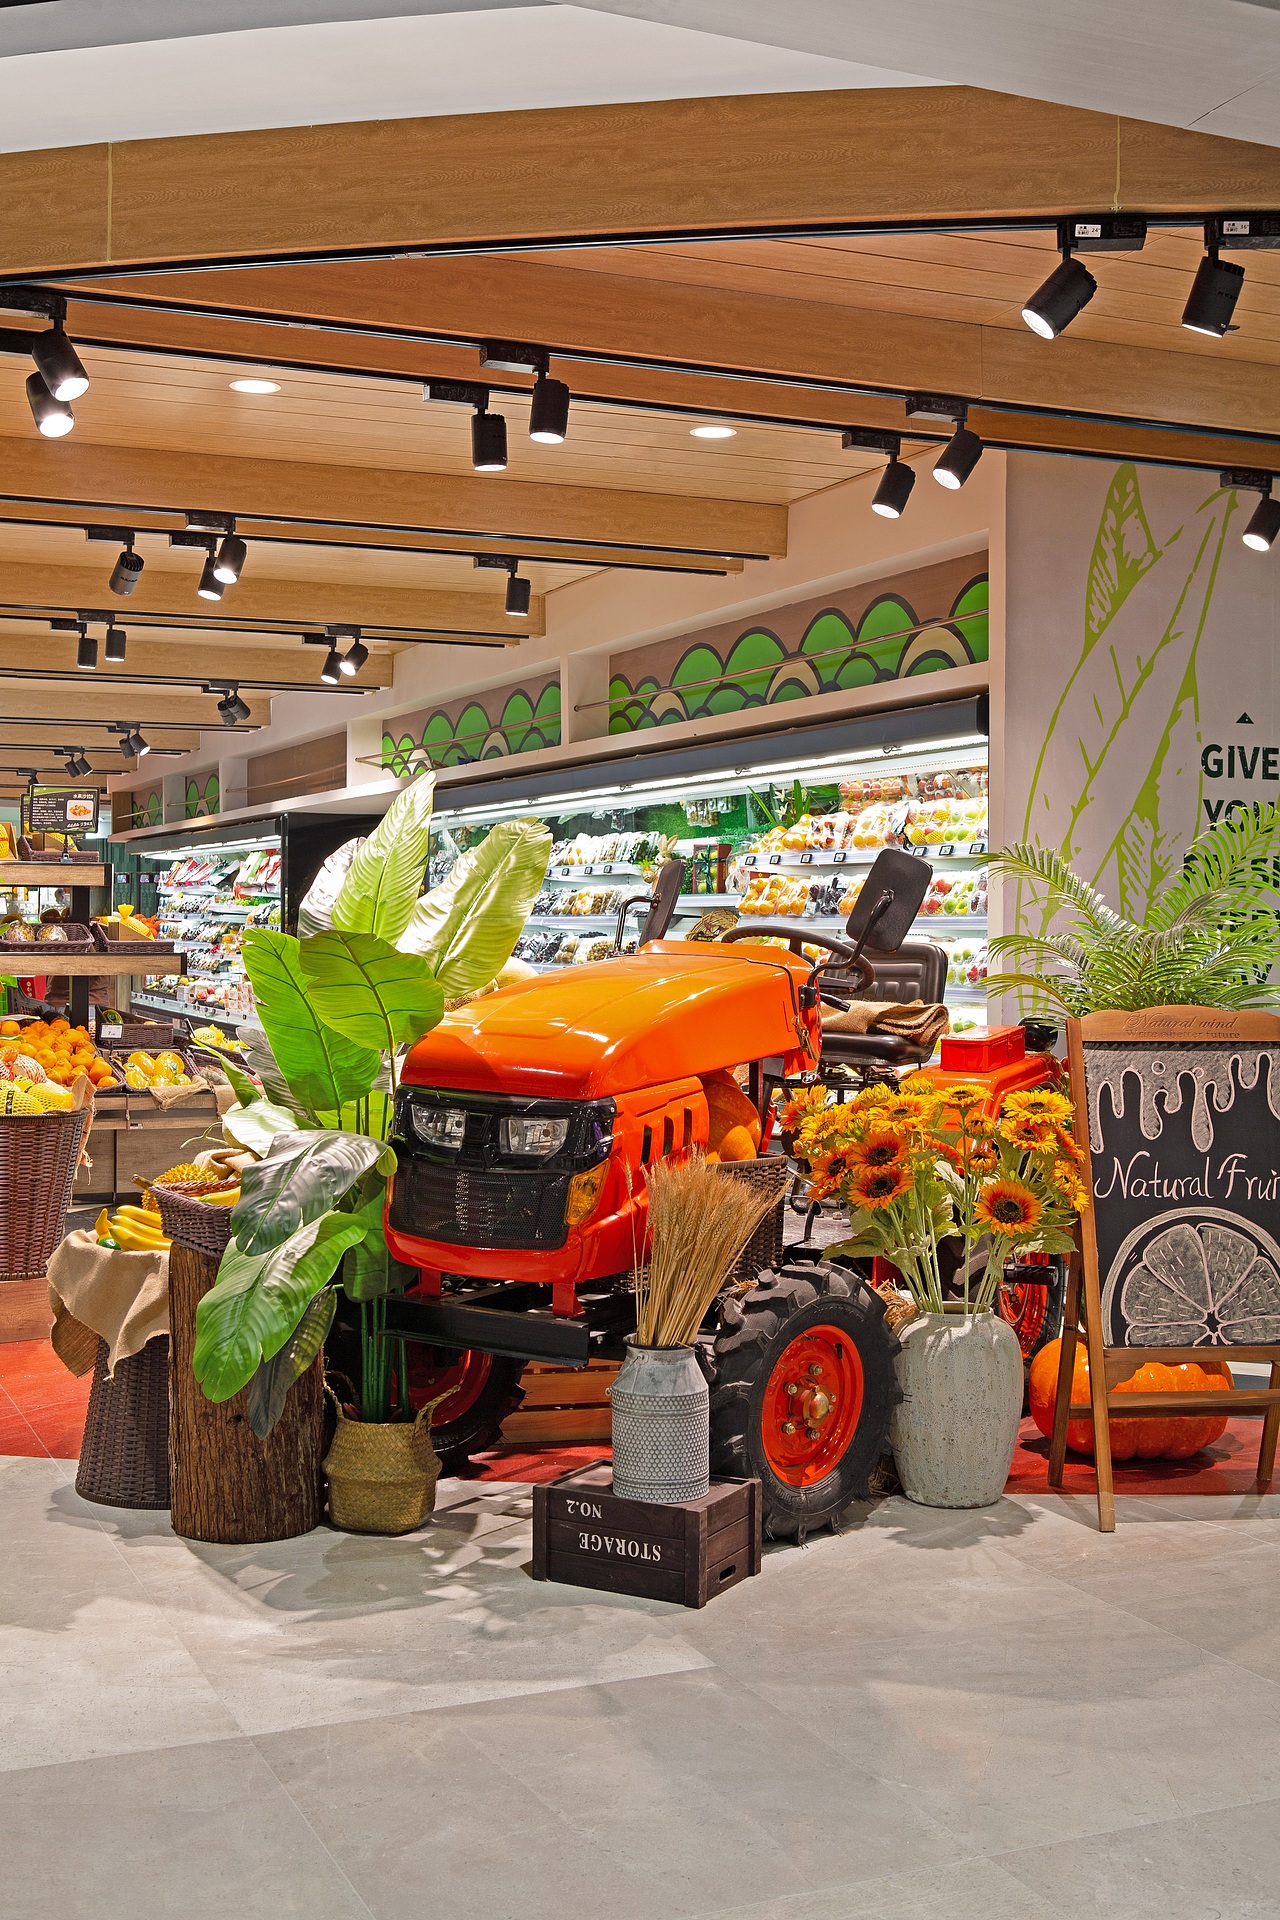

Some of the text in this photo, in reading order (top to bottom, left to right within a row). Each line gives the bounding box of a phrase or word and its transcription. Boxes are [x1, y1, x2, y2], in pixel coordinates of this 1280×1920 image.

[1201, 744, 1279, 780] GIVE
[1123, 1012, 1239, 1029] Natural wind
[1205, 1030, 1241, 1039] future
[1094, 1150, 1280, 1200] Natural Frui
[566, 1499, 602, 1519] NO.2
[579, 1532, 661, 1562] STORAGE
